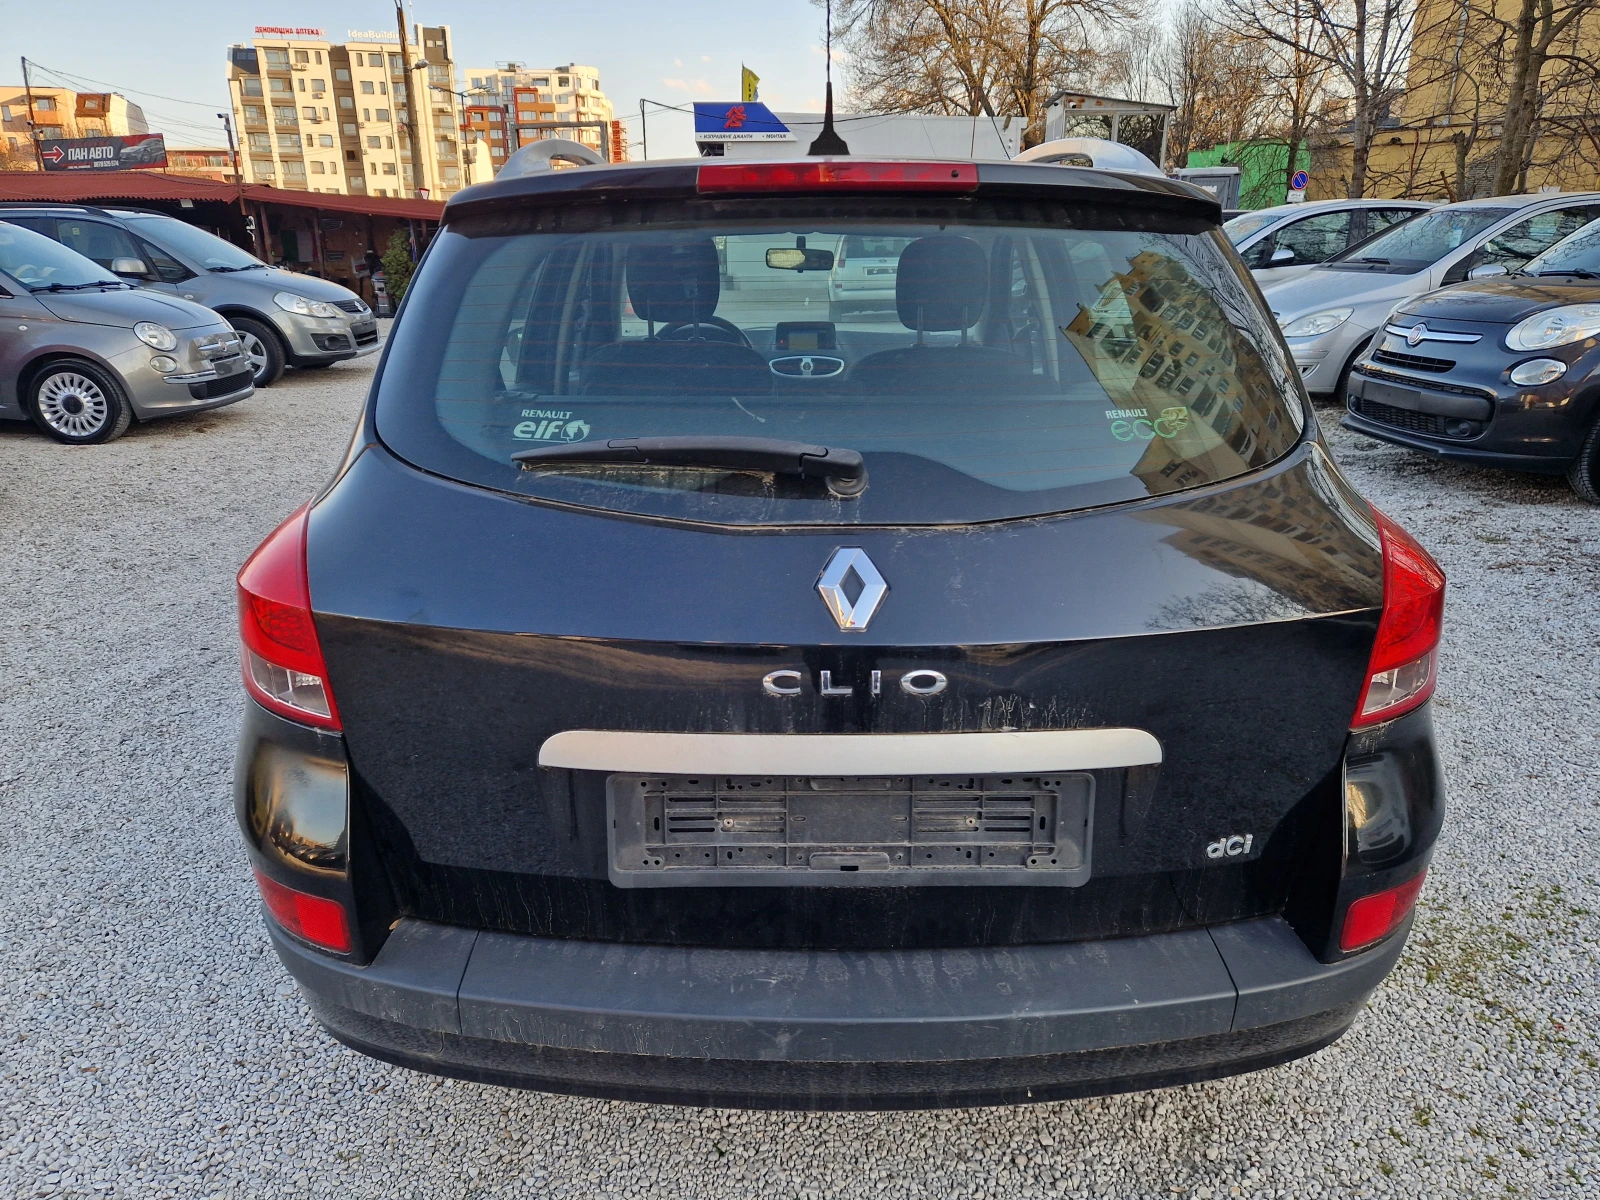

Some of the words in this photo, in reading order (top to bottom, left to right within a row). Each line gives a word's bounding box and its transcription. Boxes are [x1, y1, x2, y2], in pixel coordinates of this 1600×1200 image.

[295, 27, 319, 36] АПТЕКА
[348, 29, 412, 39] IdeaBuildins
[68, 148, 87, 160] ПАН
[89, 146, 113, 159] АВТО
[521, 409, 573, 420] RENAULT
[1105, 408, 1149, 419] RENAULT
[762, 669, 948, 696] CLIO
